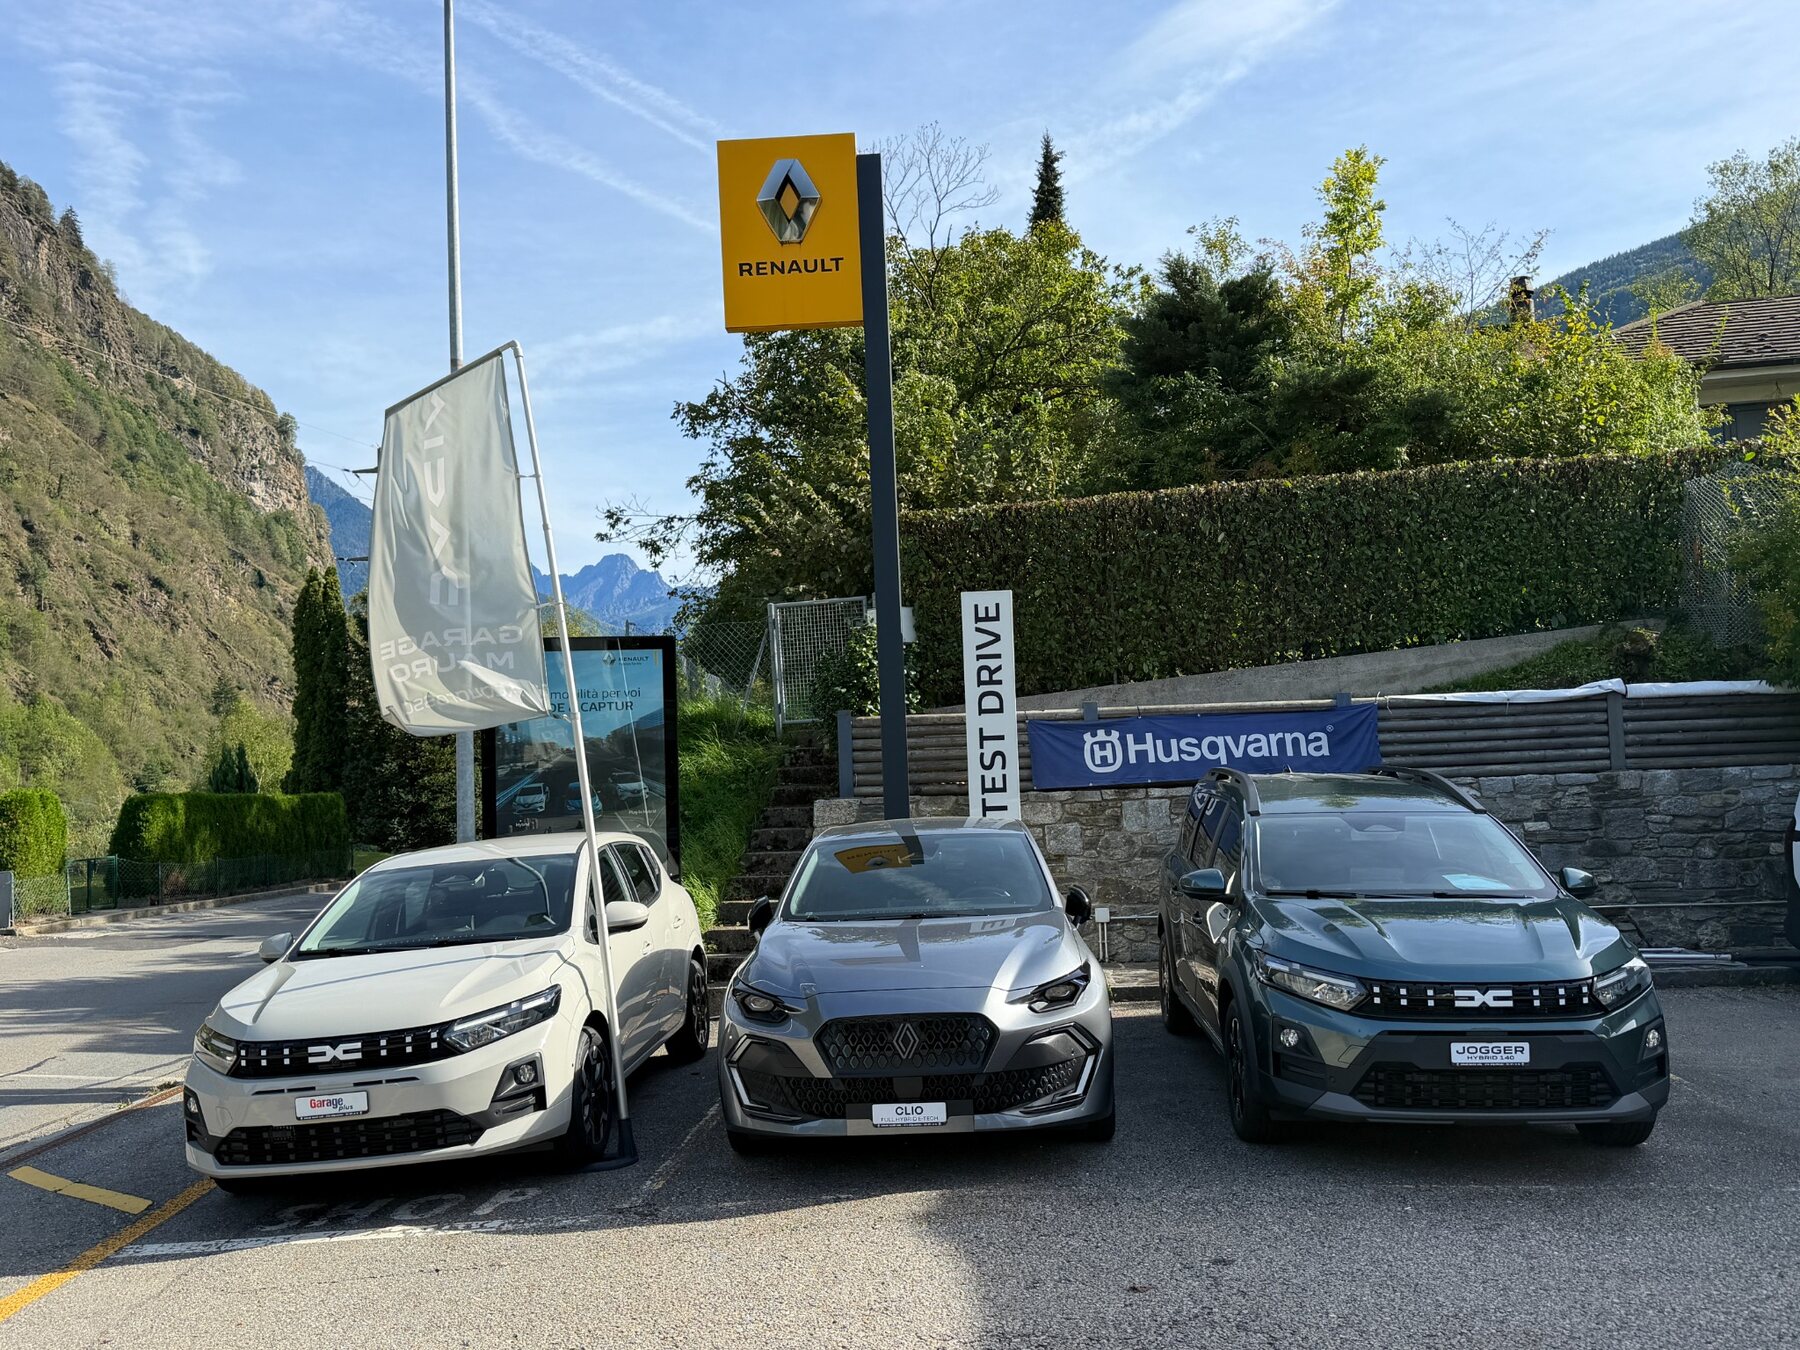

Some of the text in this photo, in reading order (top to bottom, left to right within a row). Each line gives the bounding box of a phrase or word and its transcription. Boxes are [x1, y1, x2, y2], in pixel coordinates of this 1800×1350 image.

[738, 257, 844, 276] RENAULT
[550, 687, 641, 701] moilità per voi
[581, 701, 634, 712] CAPTUR
[974, 602, 1008, 818] TEST DRIVE
[1127, 731, 1331, 765] Husqvarna
[1456, 1046, 1525, 1055] JOGGER
[310, 1097, 344, 1109] Garage
[895, 1106, 924, 1115] CLIO
